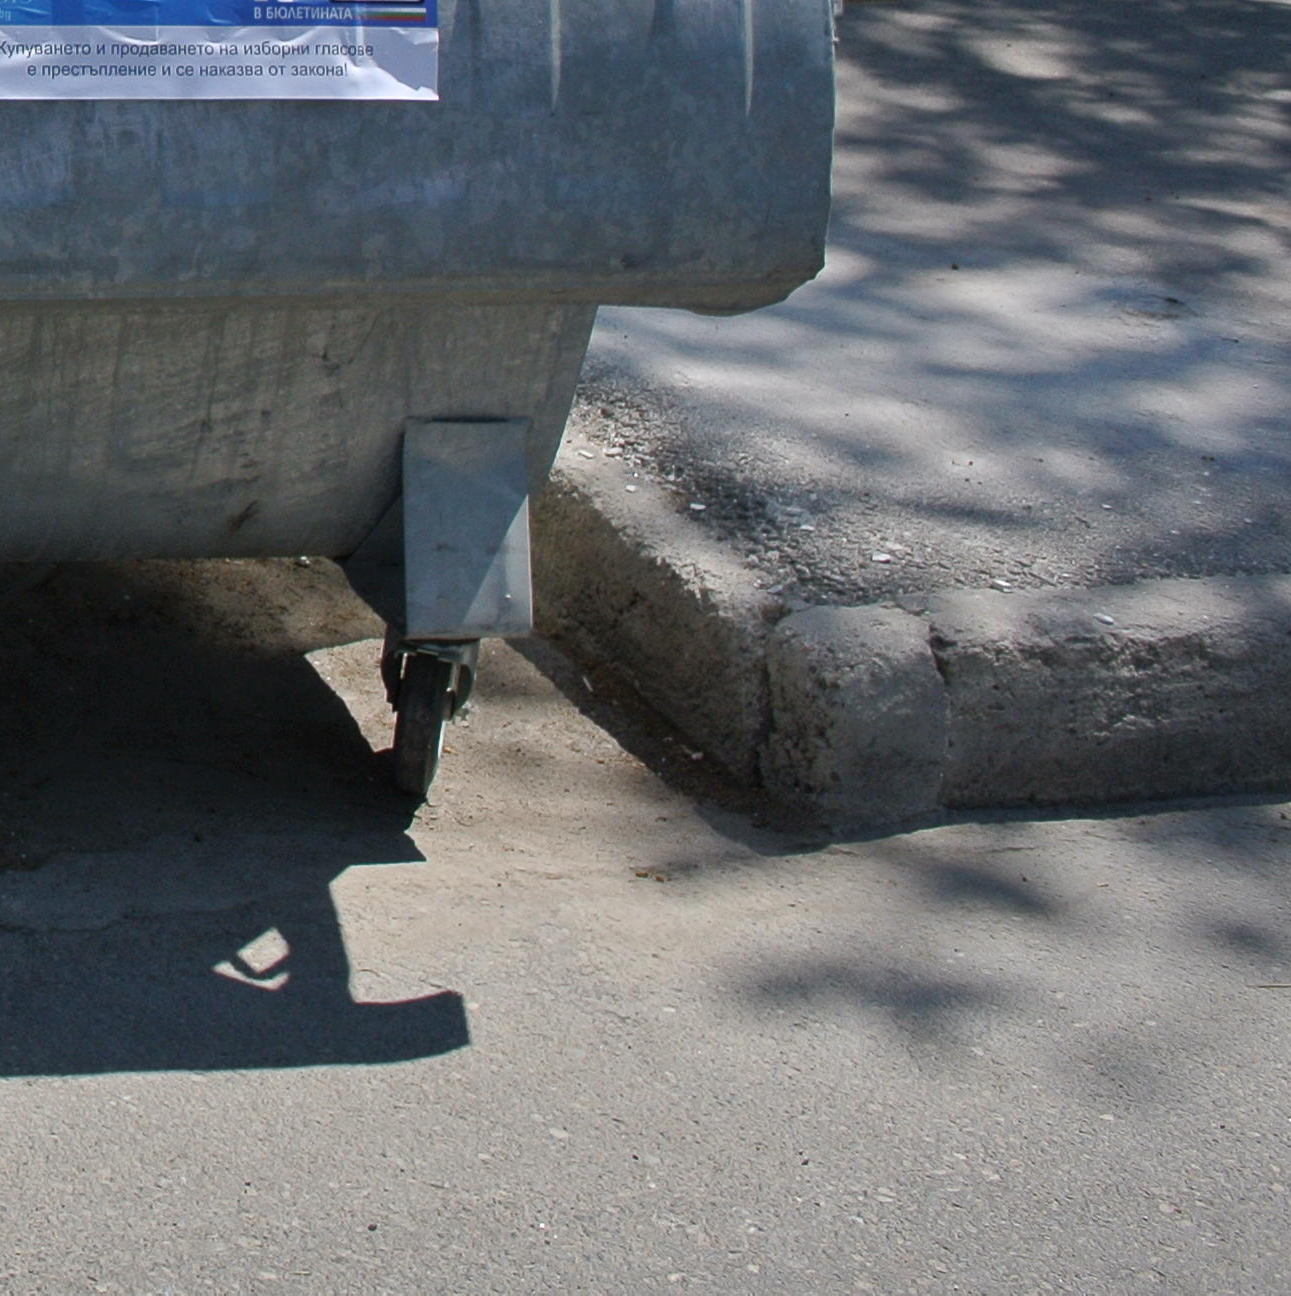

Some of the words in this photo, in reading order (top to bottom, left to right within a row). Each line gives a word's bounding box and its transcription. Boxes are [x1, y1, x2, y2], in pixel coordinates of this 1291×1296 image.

[254, 6, 263, 20] В
[267, 6, 353, 20] БЮЛЕТИНАТА
[96, 44, 106, 56] и
[111, 43, 214, 59] продаването
[220, 44, 239, 55] на
[244, 40, 309, 57] изборни
[315, 45, 374, 57] гласове
[27, 65, 37, 77] е
[41, 64, 157, 79] престъпление
[162, 65, 172, 76] и
[177, 65, 195, 76] се
[199, 64, 265, 76] наказва
[269, 64, 287, 76] от
[291, 62, 348, 77] закона!
